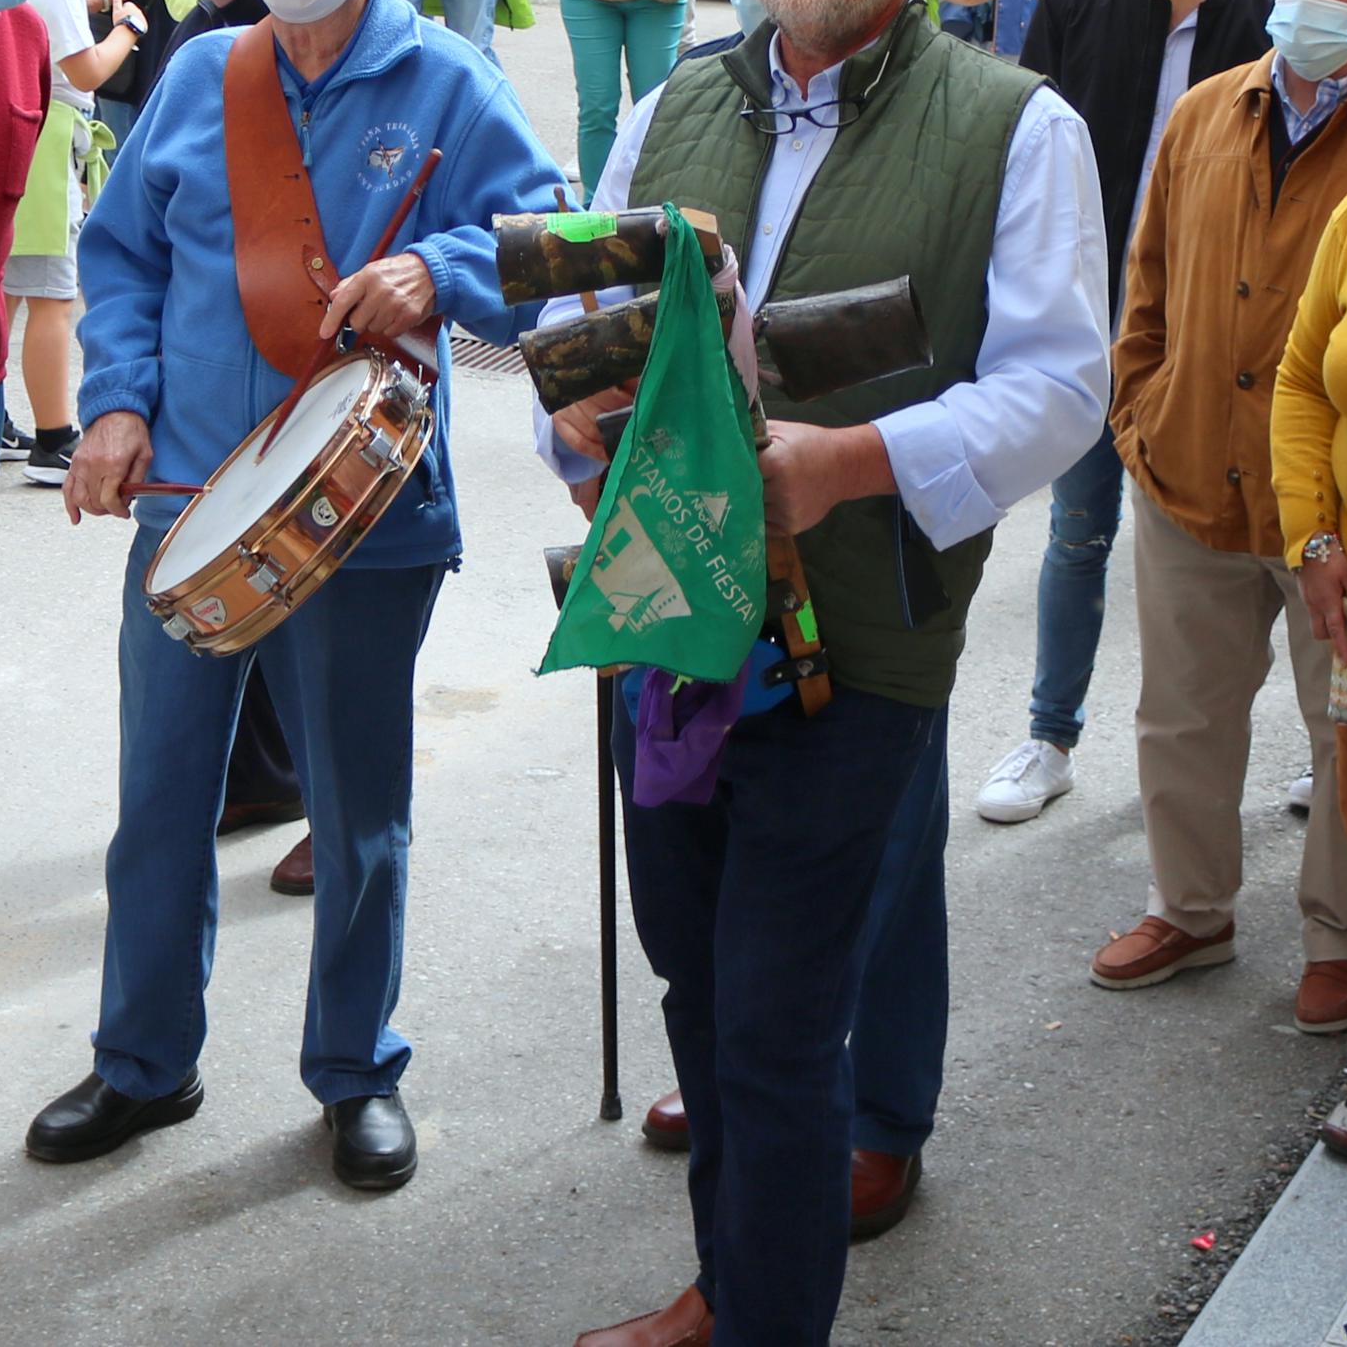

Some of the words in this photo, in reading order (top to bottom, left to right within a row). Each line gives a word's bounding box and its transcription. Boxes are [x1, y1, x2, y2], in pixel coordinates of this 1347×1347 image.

[631, 438, 692, 525] STAMOS
[684, 523, 713, 555] DE
[706, 554, 758, 625] FIESTA!
